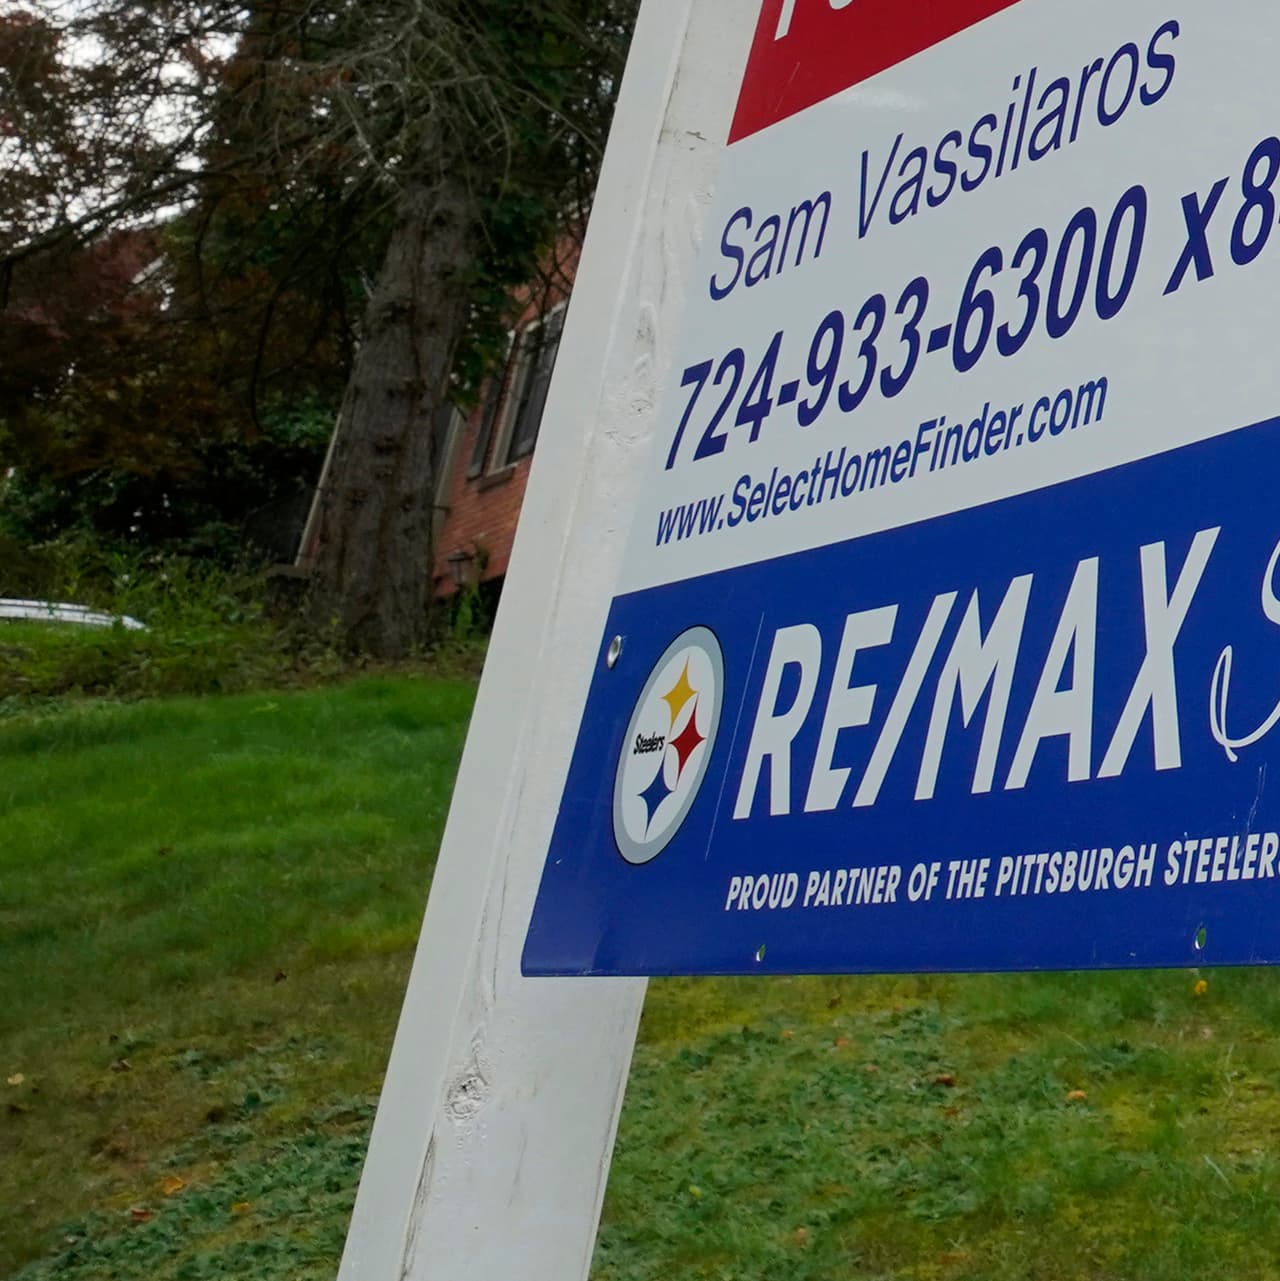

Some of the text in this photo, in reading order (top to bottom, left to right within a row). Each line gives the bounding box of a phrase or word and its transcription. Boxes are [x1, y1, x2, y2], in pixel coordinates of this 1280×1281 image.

[709, 20, 1179, 301] Sam Vassilaros
[665, 185, 1147, 470] 724-933-6300
[655, 377, 1107, 547] www.SelectHomeFinder.com
[633, 732, 665, 755] Steelers
[733, 527, 1221, 819] RE/MAX
[725, 872, 798, 910] PROUD
[804, 866, 901, 907] PARTNER
[908, 862, 941, 901] OF
[946, 858, 990, 899] THE
[995, 844, 1156, 897] PITTSBURGH
